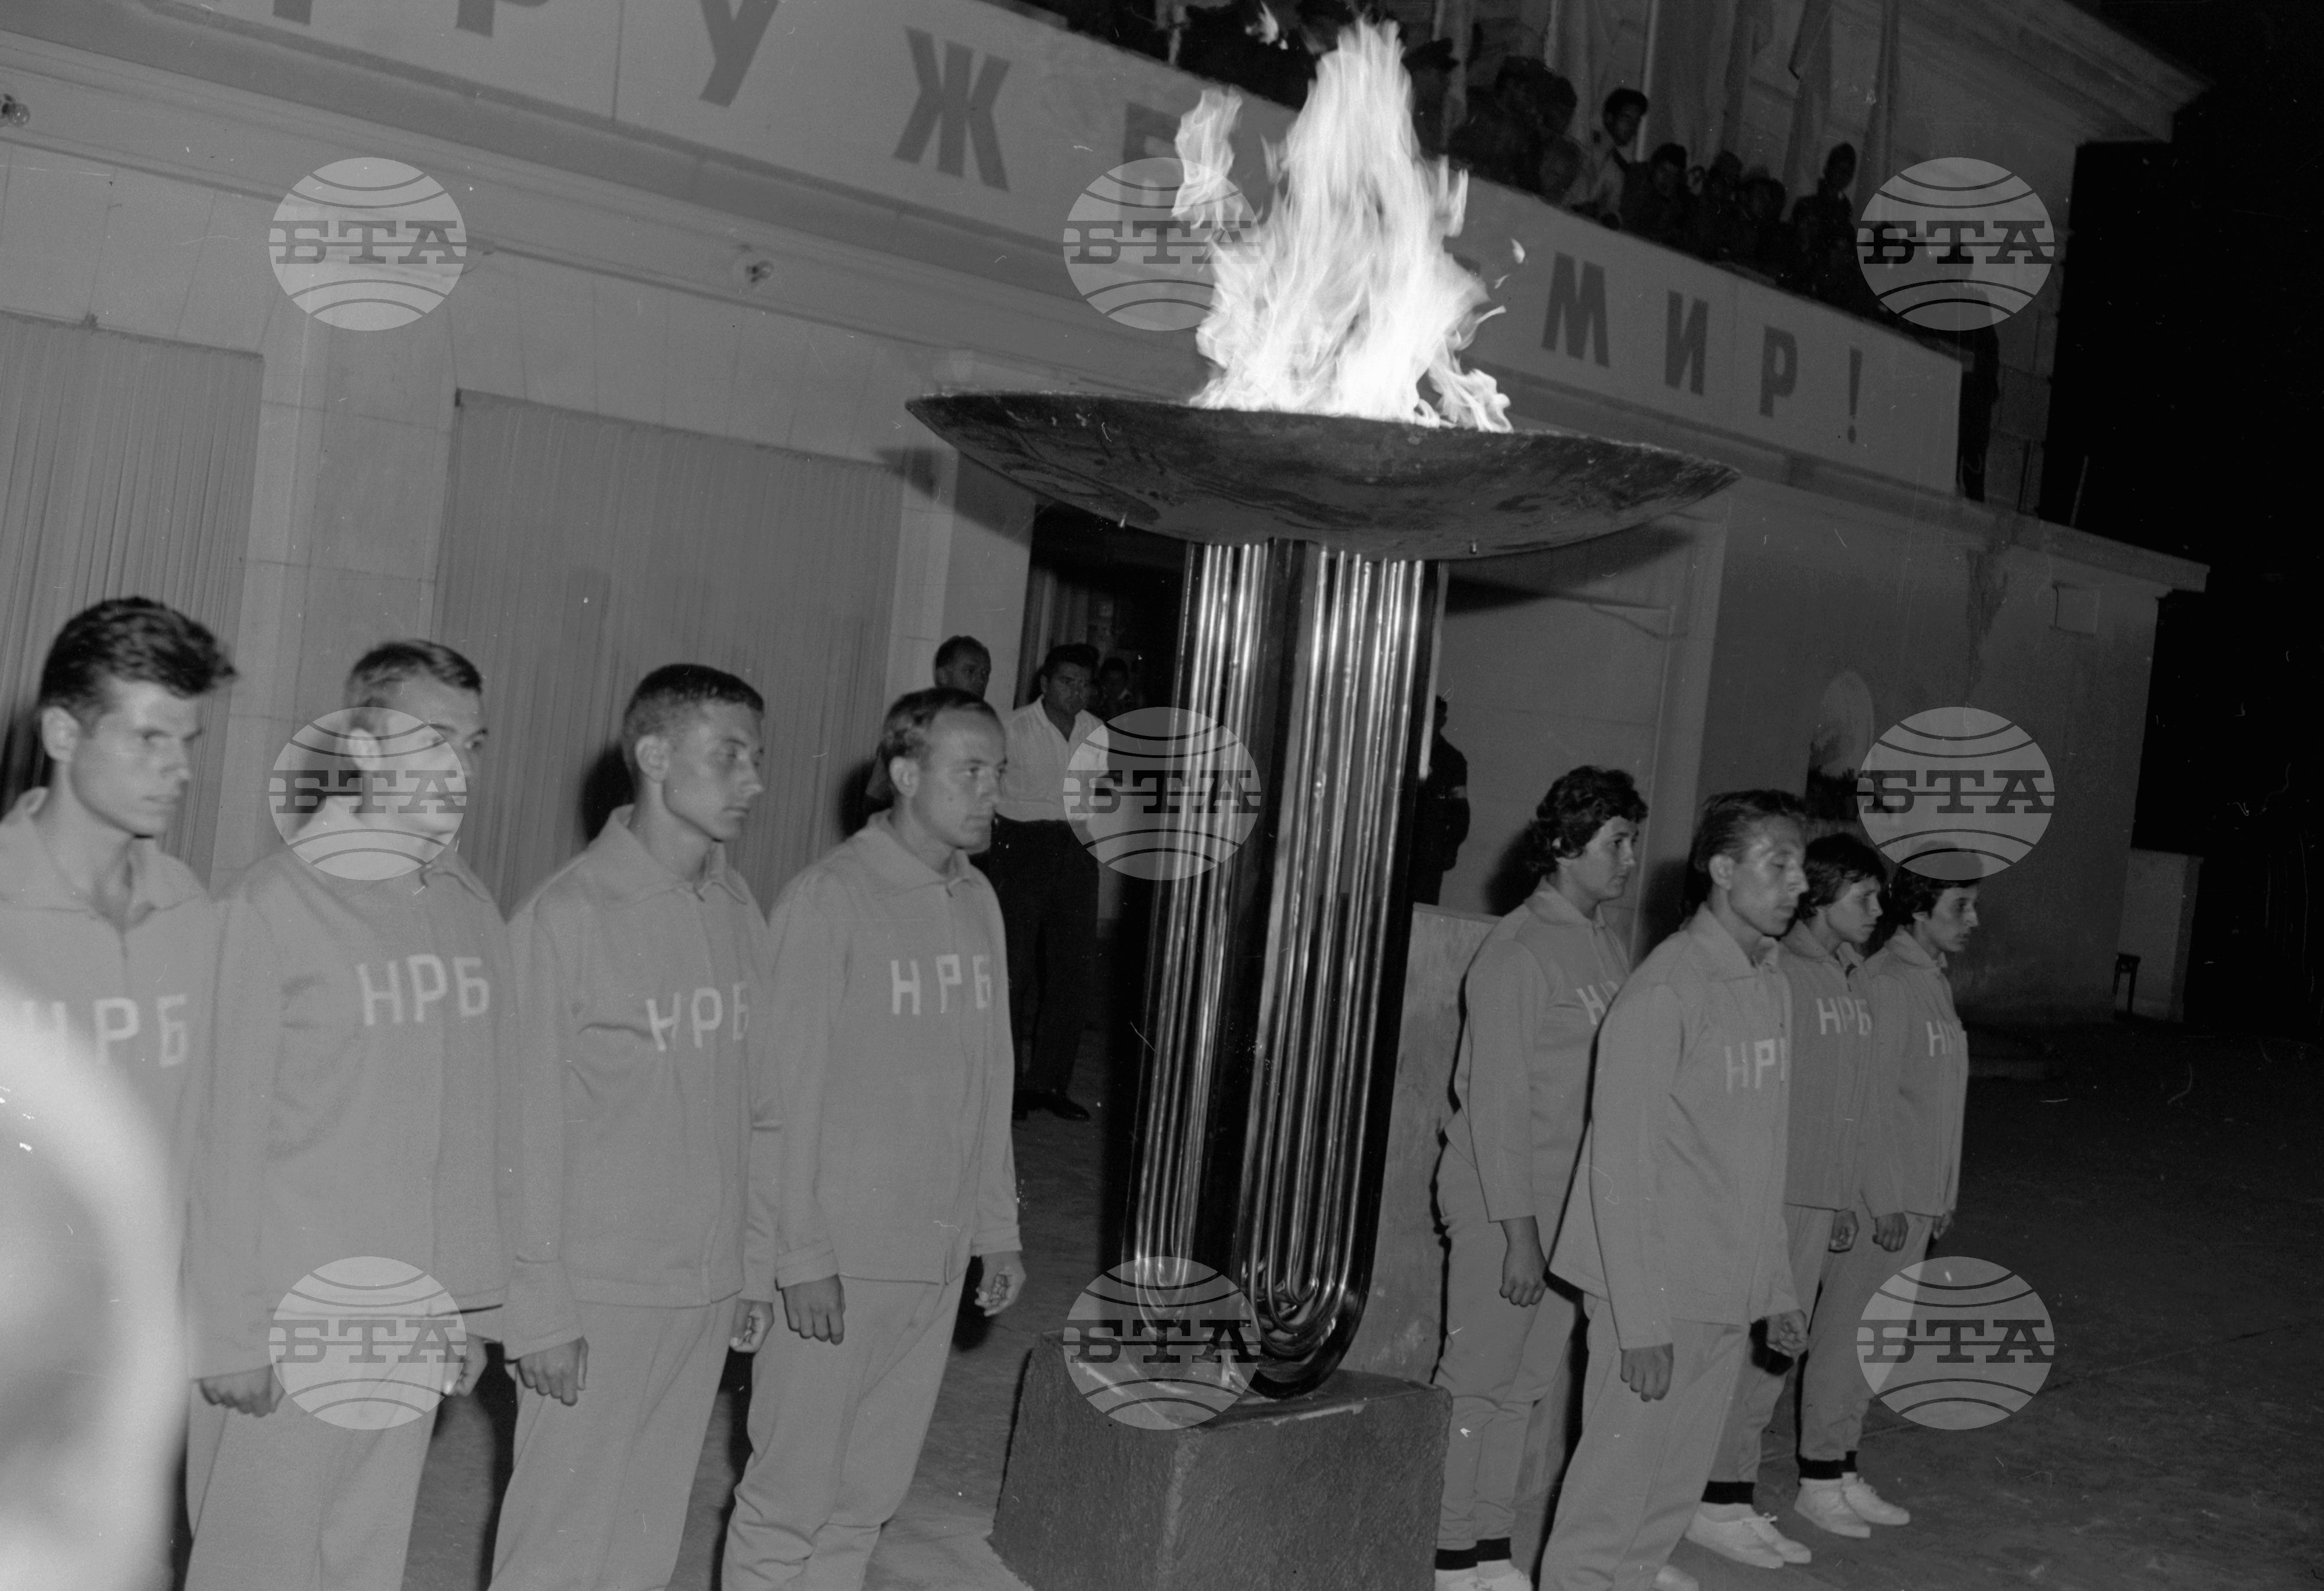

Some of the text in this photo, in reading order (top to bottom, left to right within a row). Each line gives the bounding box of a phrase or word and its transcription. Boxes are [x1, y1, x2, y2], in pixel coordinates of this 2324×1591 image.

[1540, 252, 1862, 445] МИР!
[355, 953, 491, 1026] НРБ
[645, 980, 750, 1053] НРБ
[890, 953, 991, 1015] НРБ
[1815, 995, 1874, 1036] НРБ
[1724, 1037, 1786, 1094] НР
